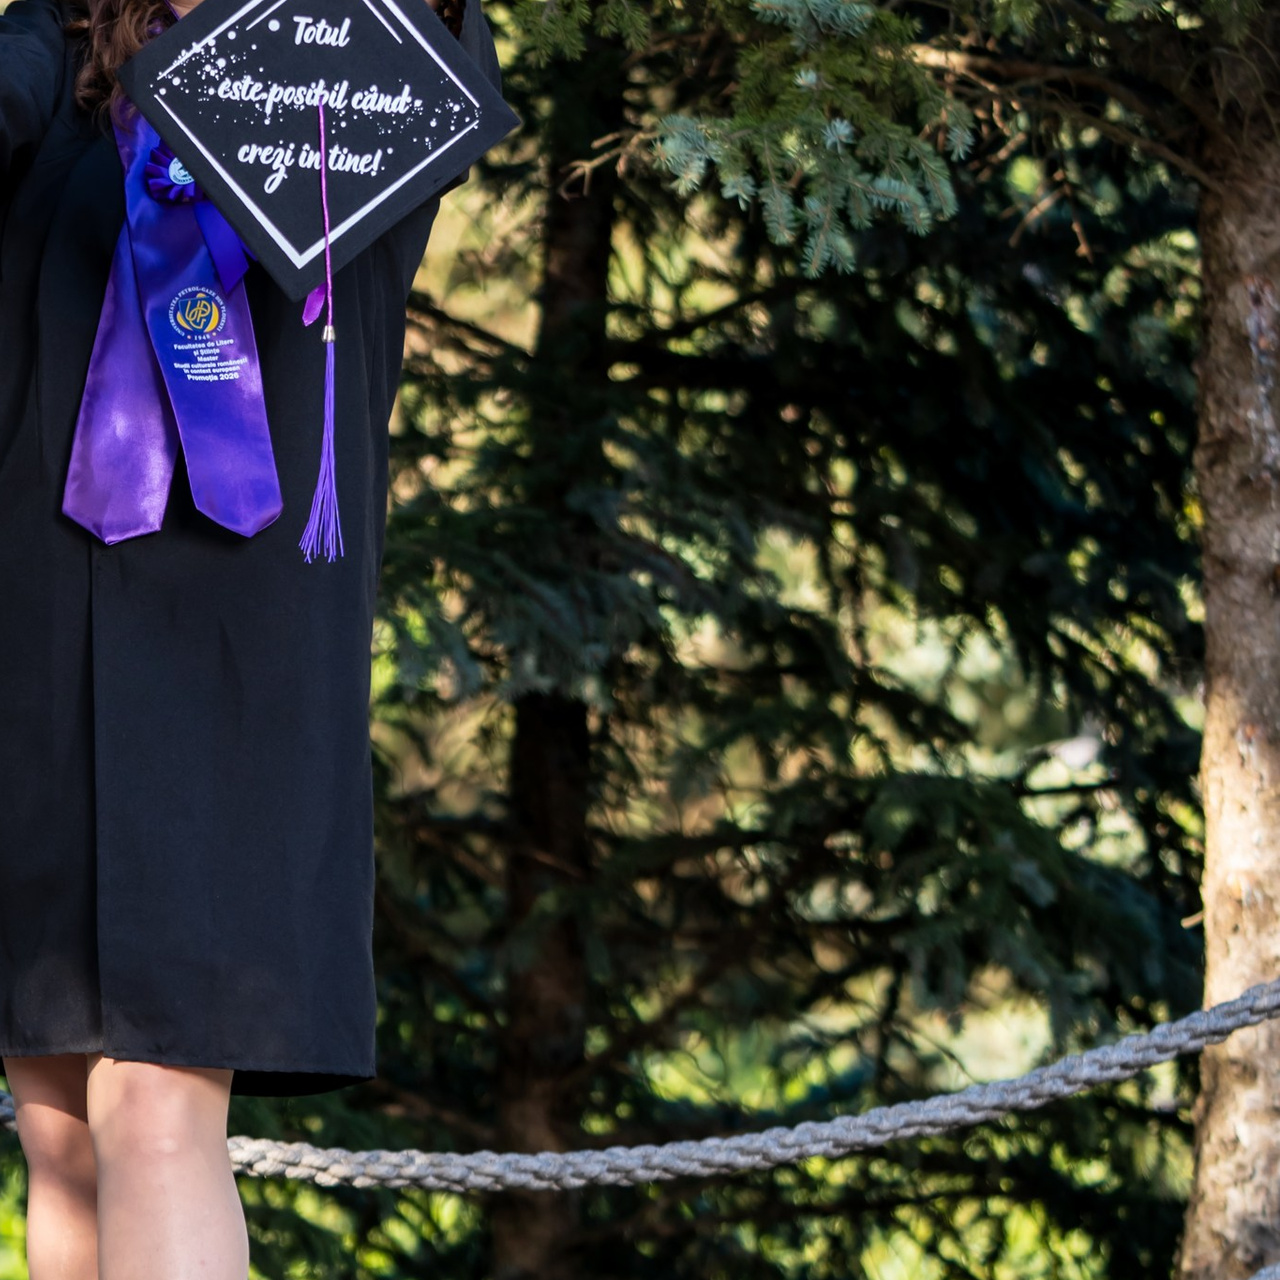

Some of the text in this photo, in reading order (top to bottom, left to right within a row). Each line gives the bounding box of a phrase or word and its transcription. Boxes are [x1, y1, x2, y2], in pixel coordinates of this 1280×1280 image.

[293, 16, 350, 47] Totul
[218, 76, 412, 114] este posibil când
[238, 142, 382, 194] crezi în tine!
